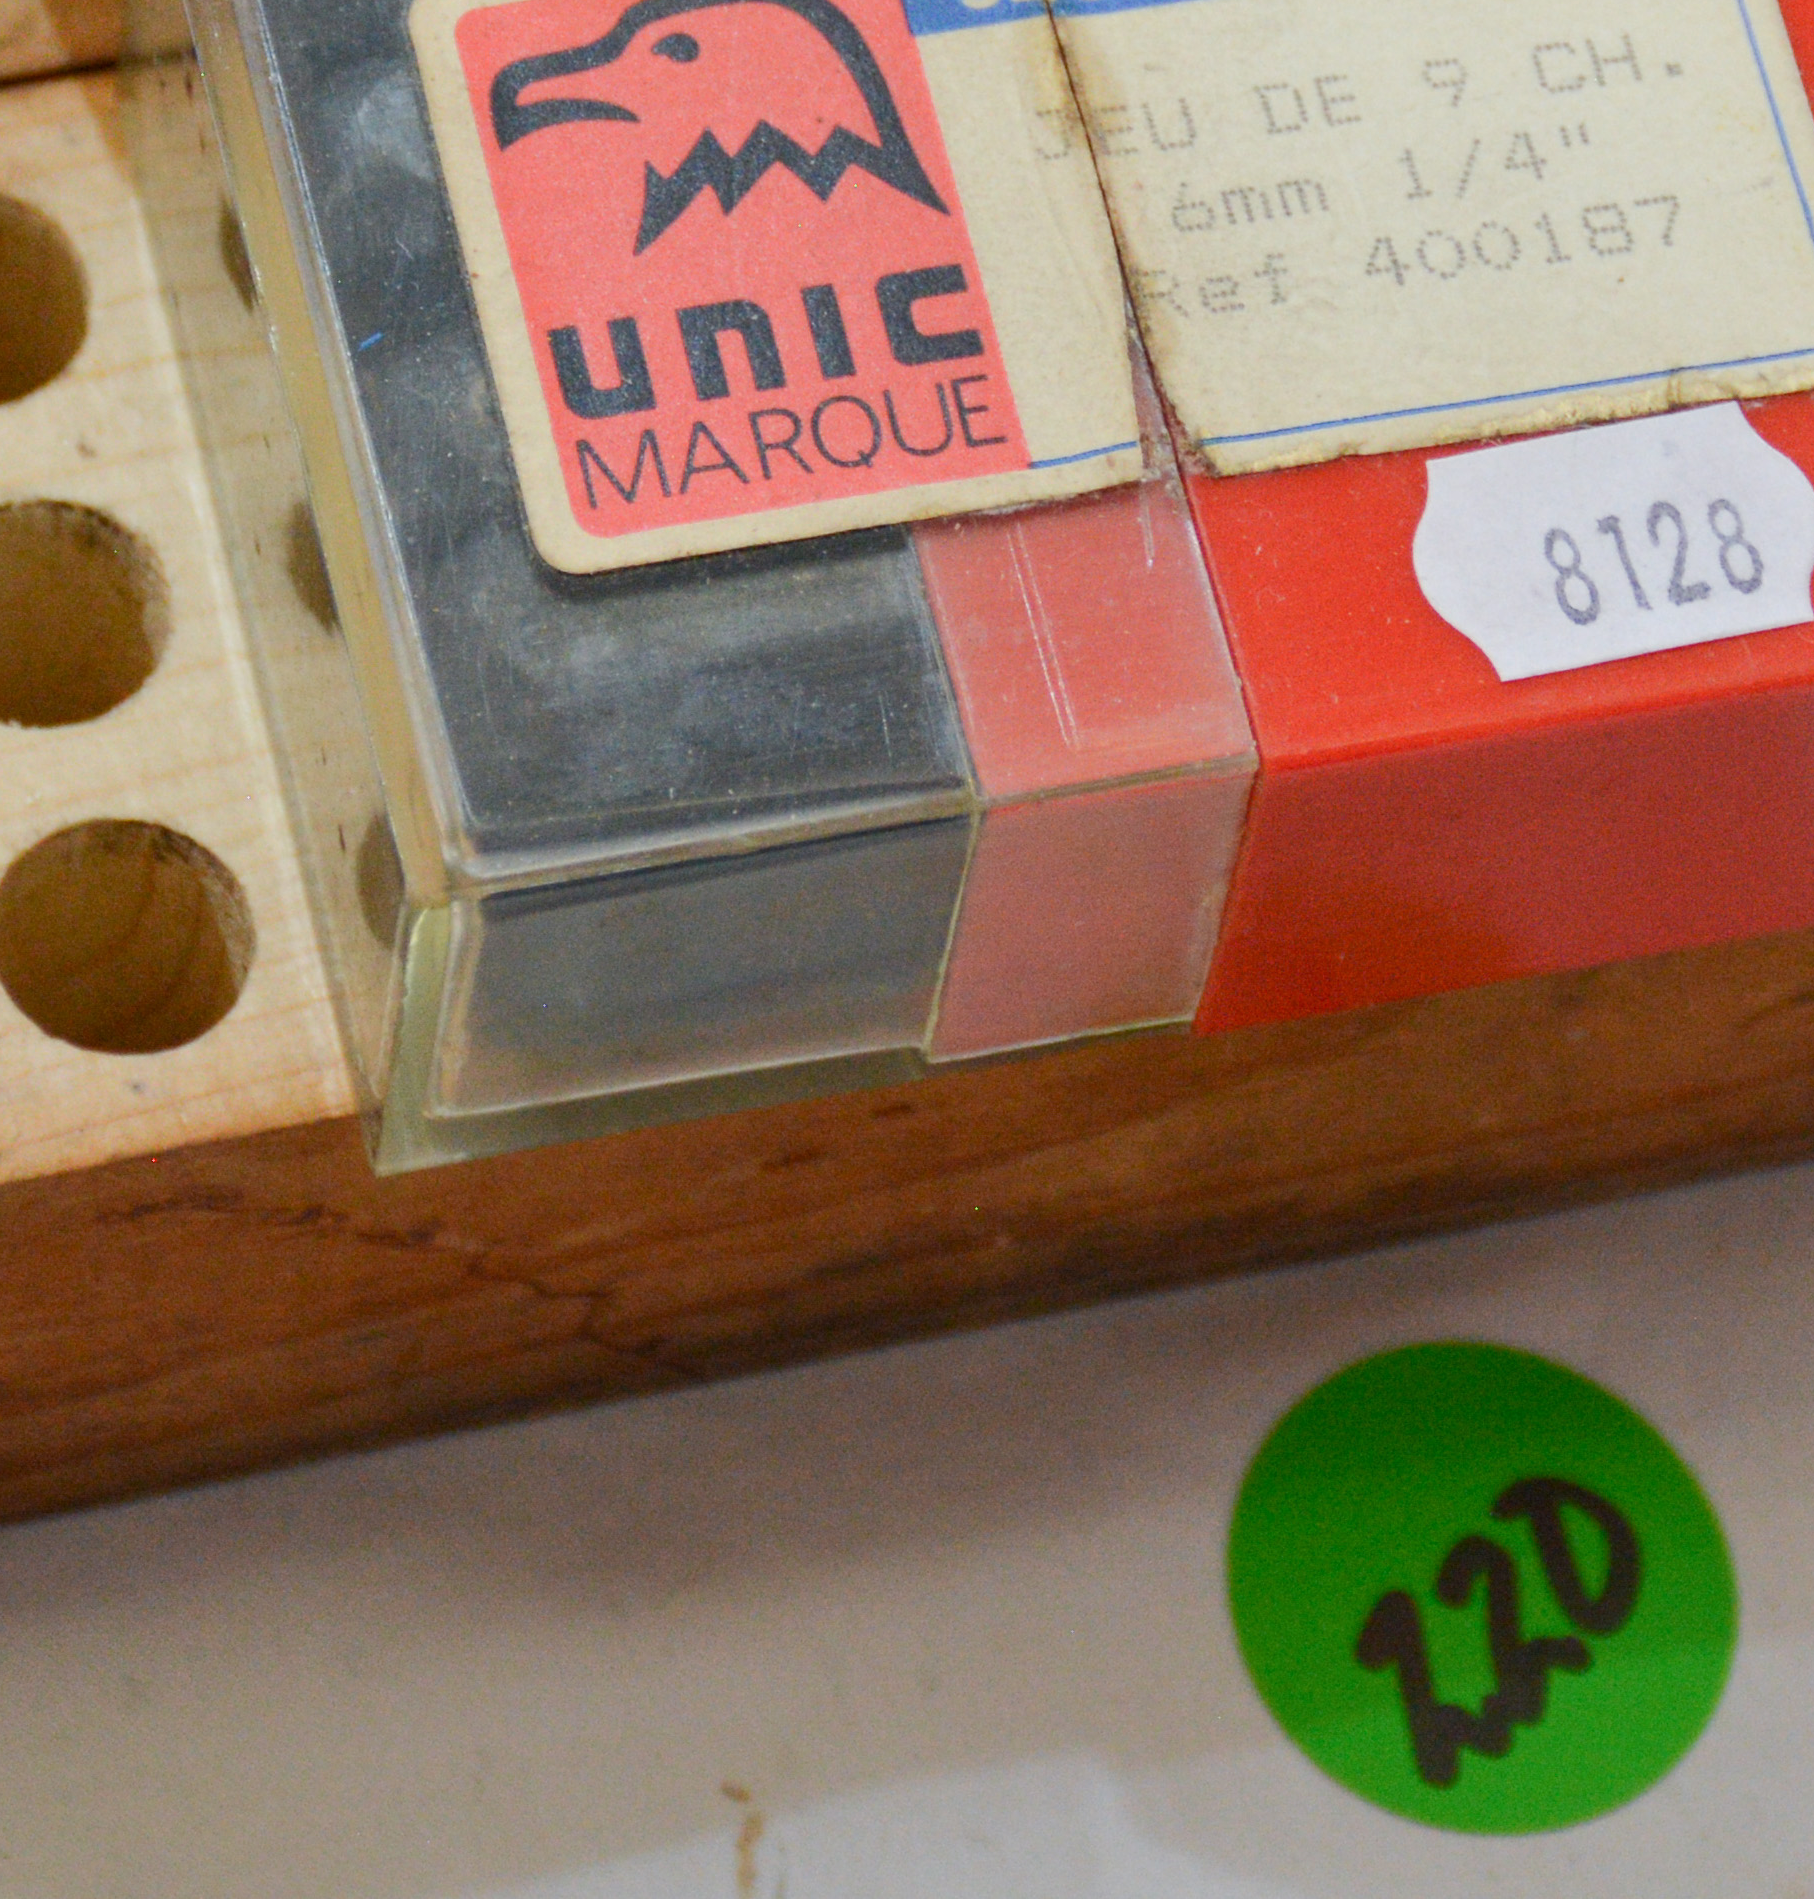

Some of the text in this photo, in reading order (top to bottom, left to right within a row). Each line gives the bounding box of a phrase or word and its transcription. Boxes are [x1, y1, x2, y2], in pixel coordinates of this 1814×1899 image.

[1035, 33, 1684, 160] JEU DE 9 CH.
[1170, 180, 1330, 234] 6mm
[1364, 193, 1681, 287] 400187
[575, 373, 1008, 510] MARQUE
[1543, 497, 1765, 626] 8128
[1355, 1475, 1643, 1788] 220
